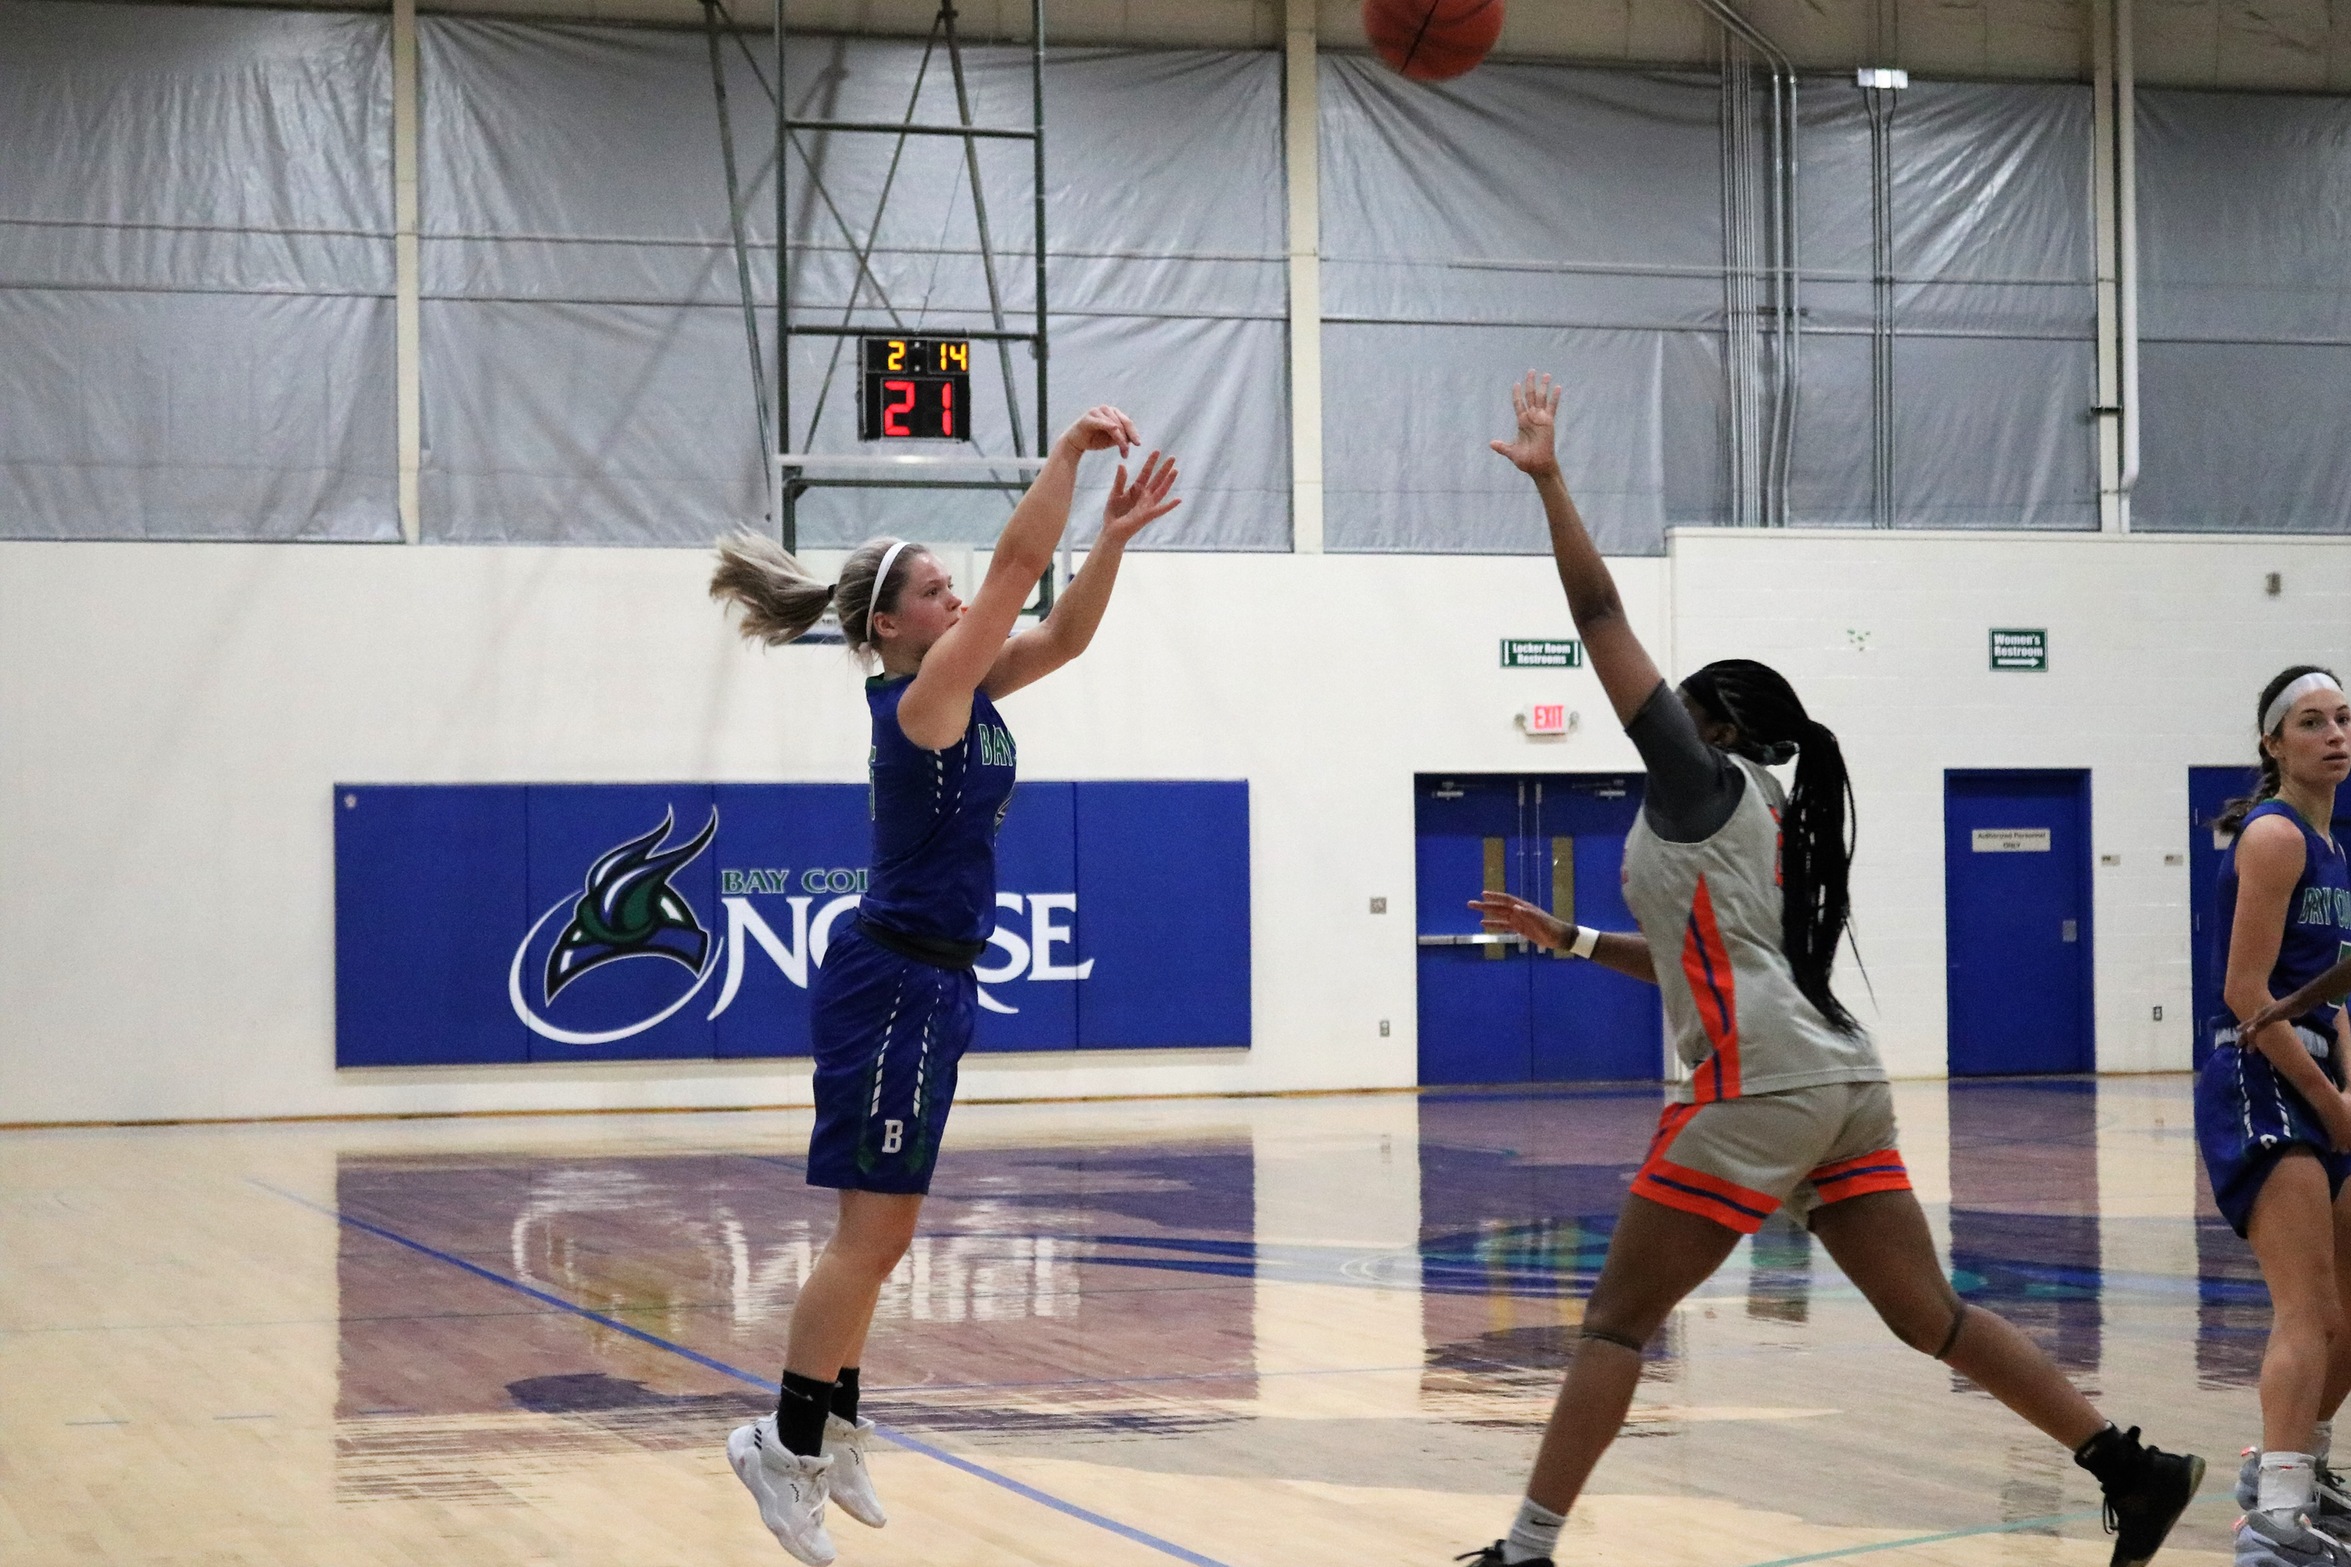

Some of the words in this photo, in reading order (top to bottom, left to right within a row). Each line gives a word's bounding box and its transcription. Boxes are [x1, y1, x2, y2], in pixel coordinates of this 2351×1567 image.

[884, 380, 952, 436] 21
[1512, 643, 1543, 654] Locker
[1994, 633, 2041, 646] Women's
[1994, 646, 2043, 657] Restroom
[1534, 705, 1564, 729] EXIT
[720, 868, 790, 895] BAY
[706, 892, 1096, 1021] NSE
[881, 1119, 904, 1154] B
